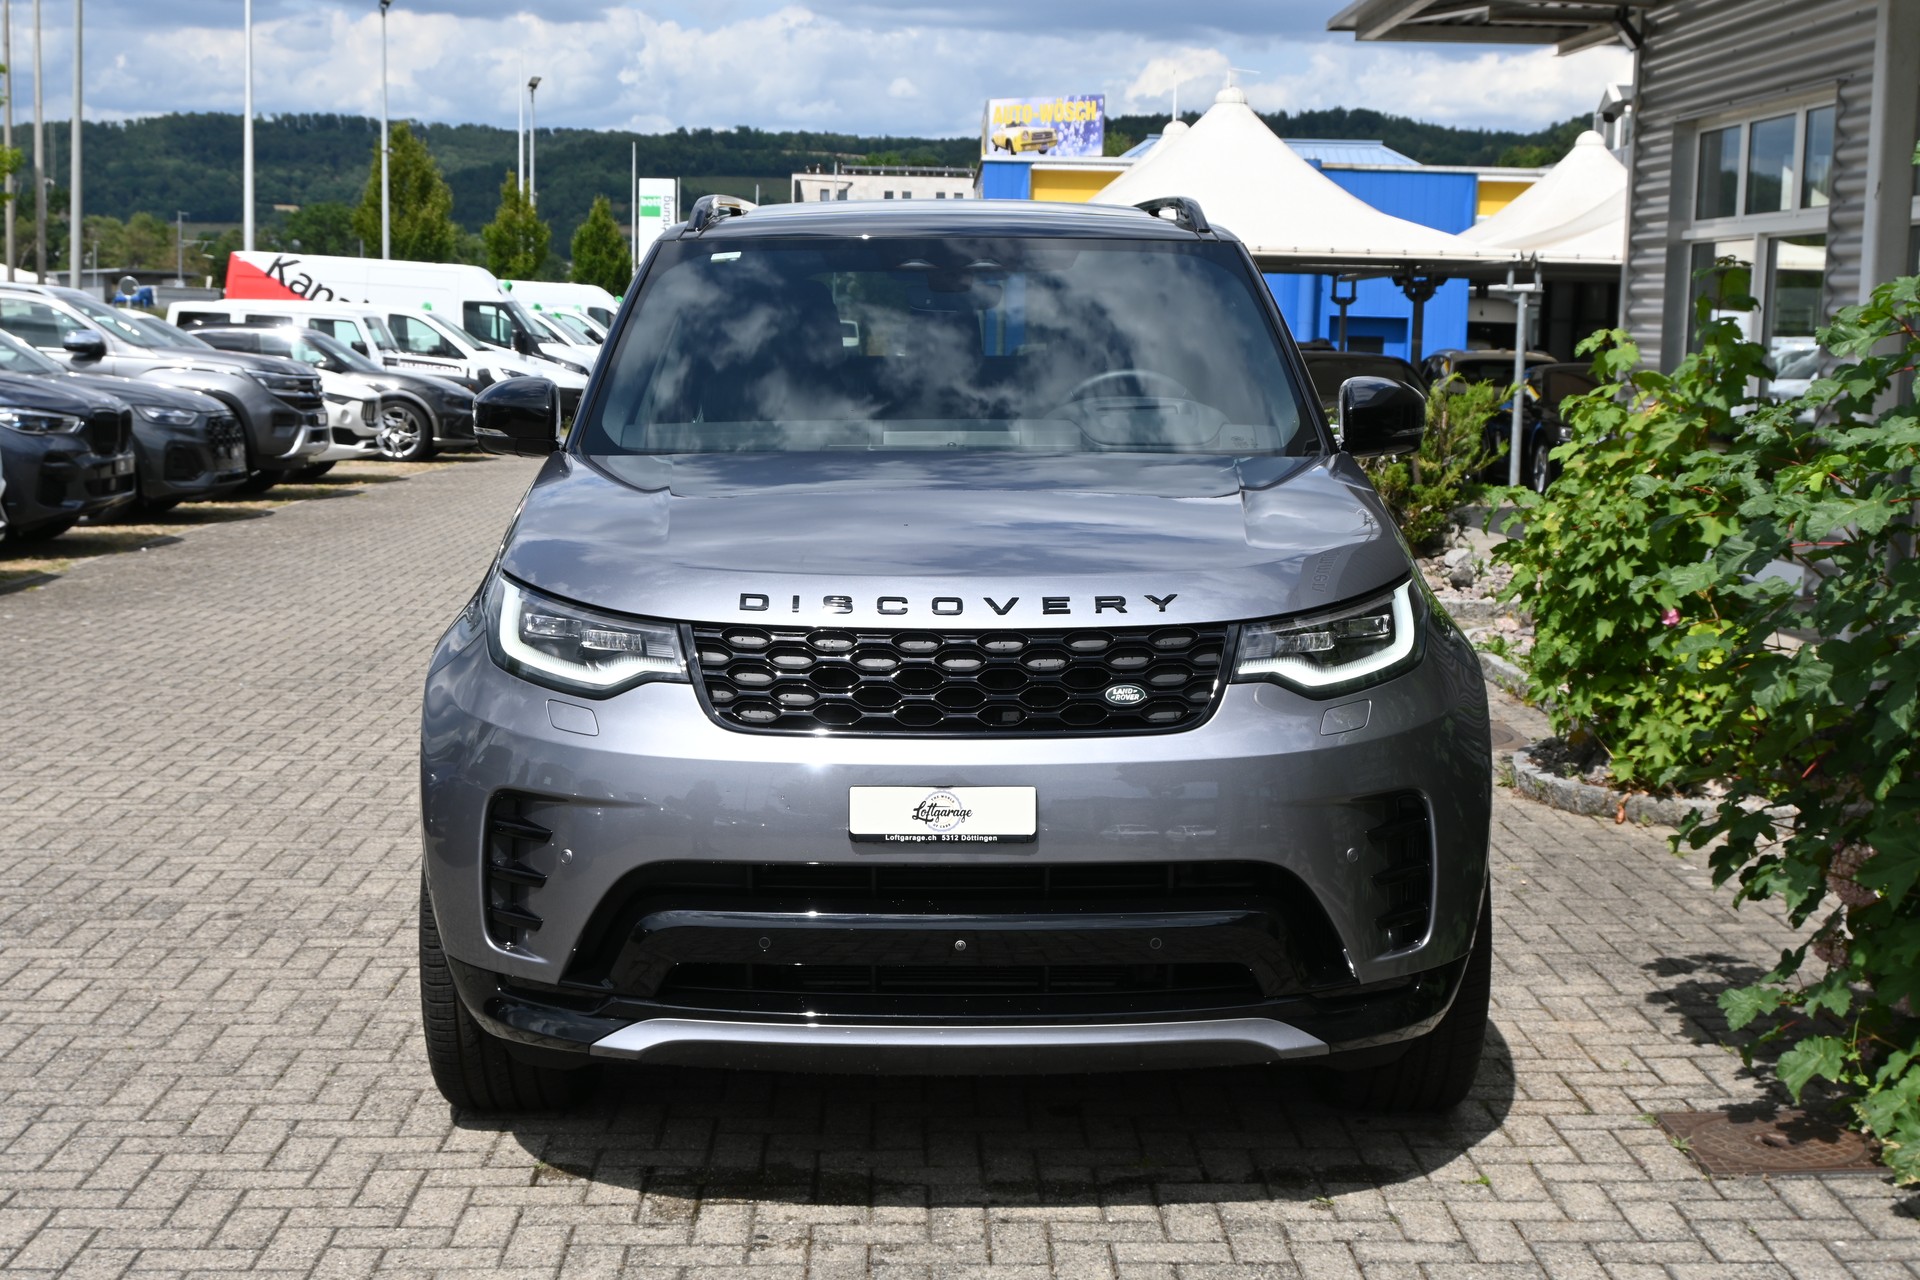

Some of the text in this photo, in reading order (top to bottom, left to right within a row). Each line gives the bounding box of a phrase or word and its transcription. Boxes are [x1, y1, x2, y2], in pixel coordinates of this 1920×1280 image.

[993, 98, 1097, 124] AUTO-WÖSCH
[739, 592, 1178, 615] DISCOVERY
[911, 800, 973, 824] Loftgarage
[885, 834, 937, 842] Loftgarage.ch
[961, 834, 998, 842] Döttingen
